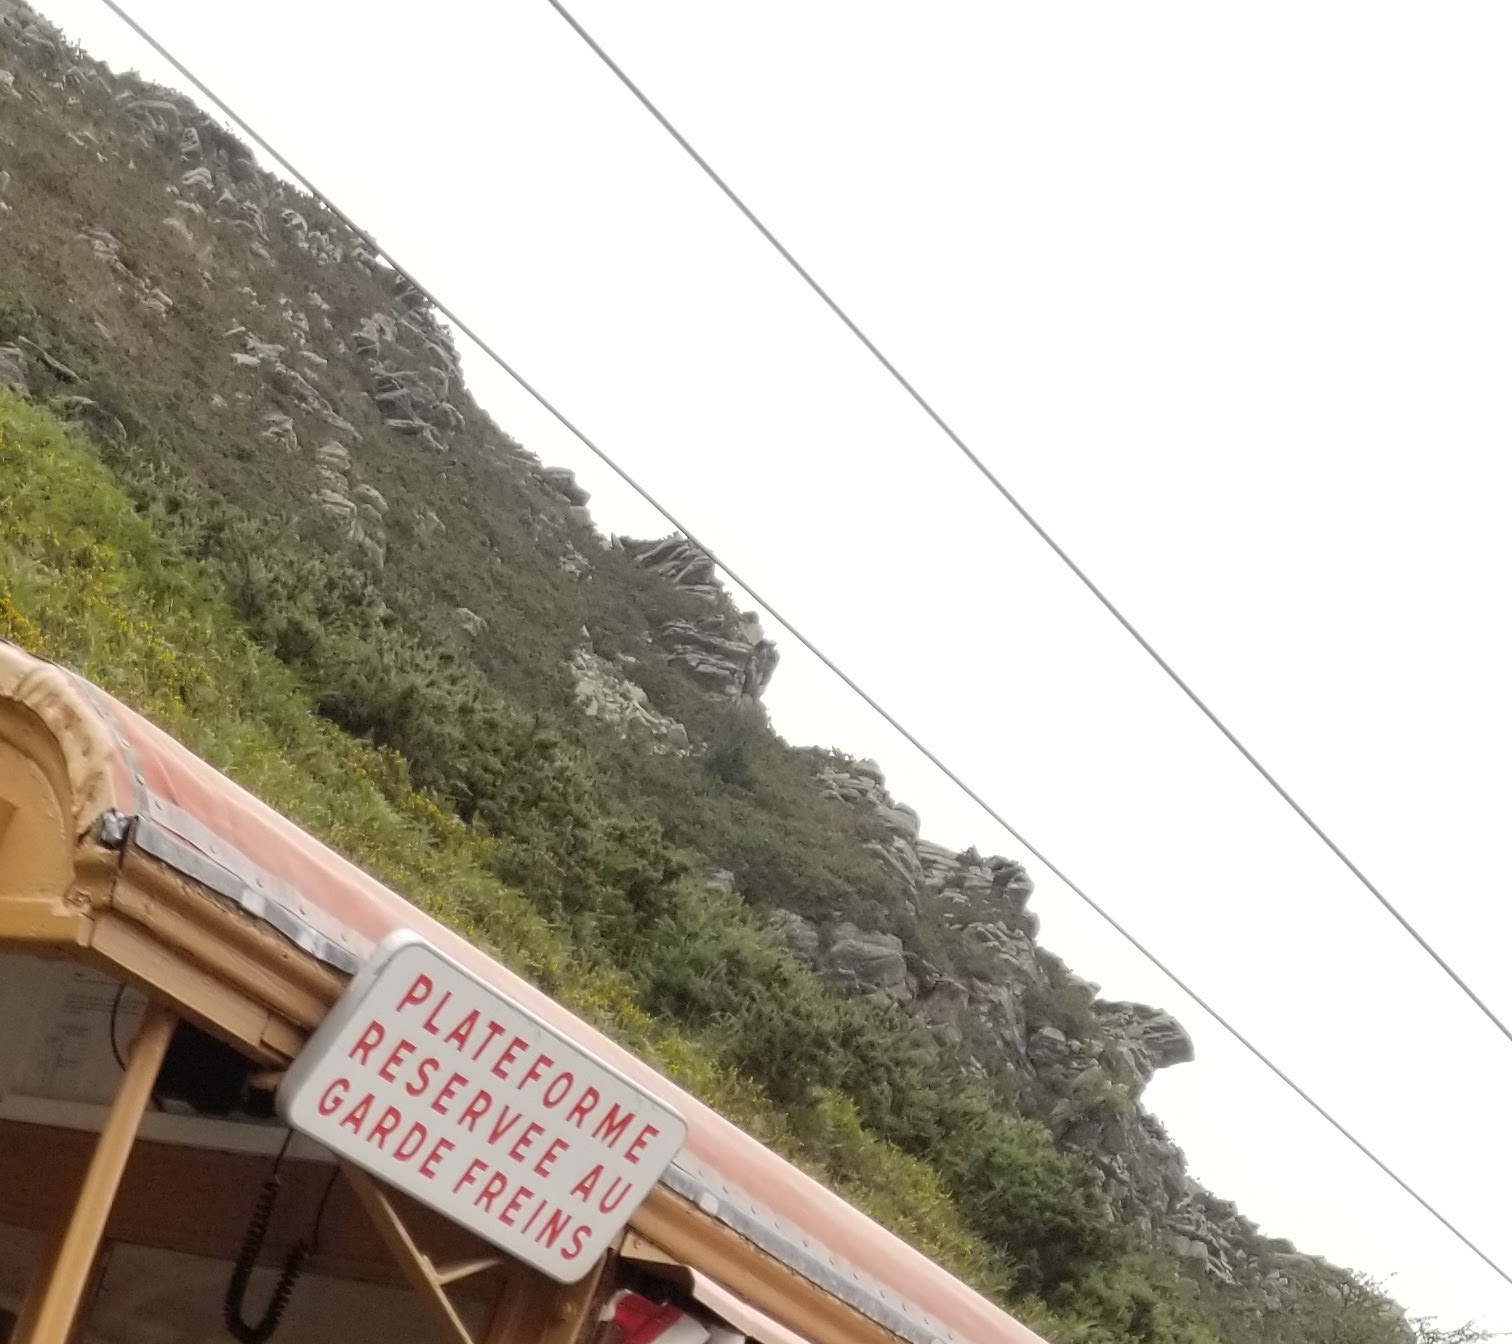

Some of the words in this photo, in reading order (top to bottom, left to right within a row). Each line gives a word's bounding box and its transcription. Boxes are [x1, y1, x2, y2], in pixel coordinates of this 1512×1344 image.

[348, 1019, 569, 1178] RESERVEE
[570, 1162, 632, 1215] AU
[396, 972, 660, 1165] PLATEFORME
[317, 1076, 455, 1180] GARDE
[452, 1157, 593, 1261] FREINS
